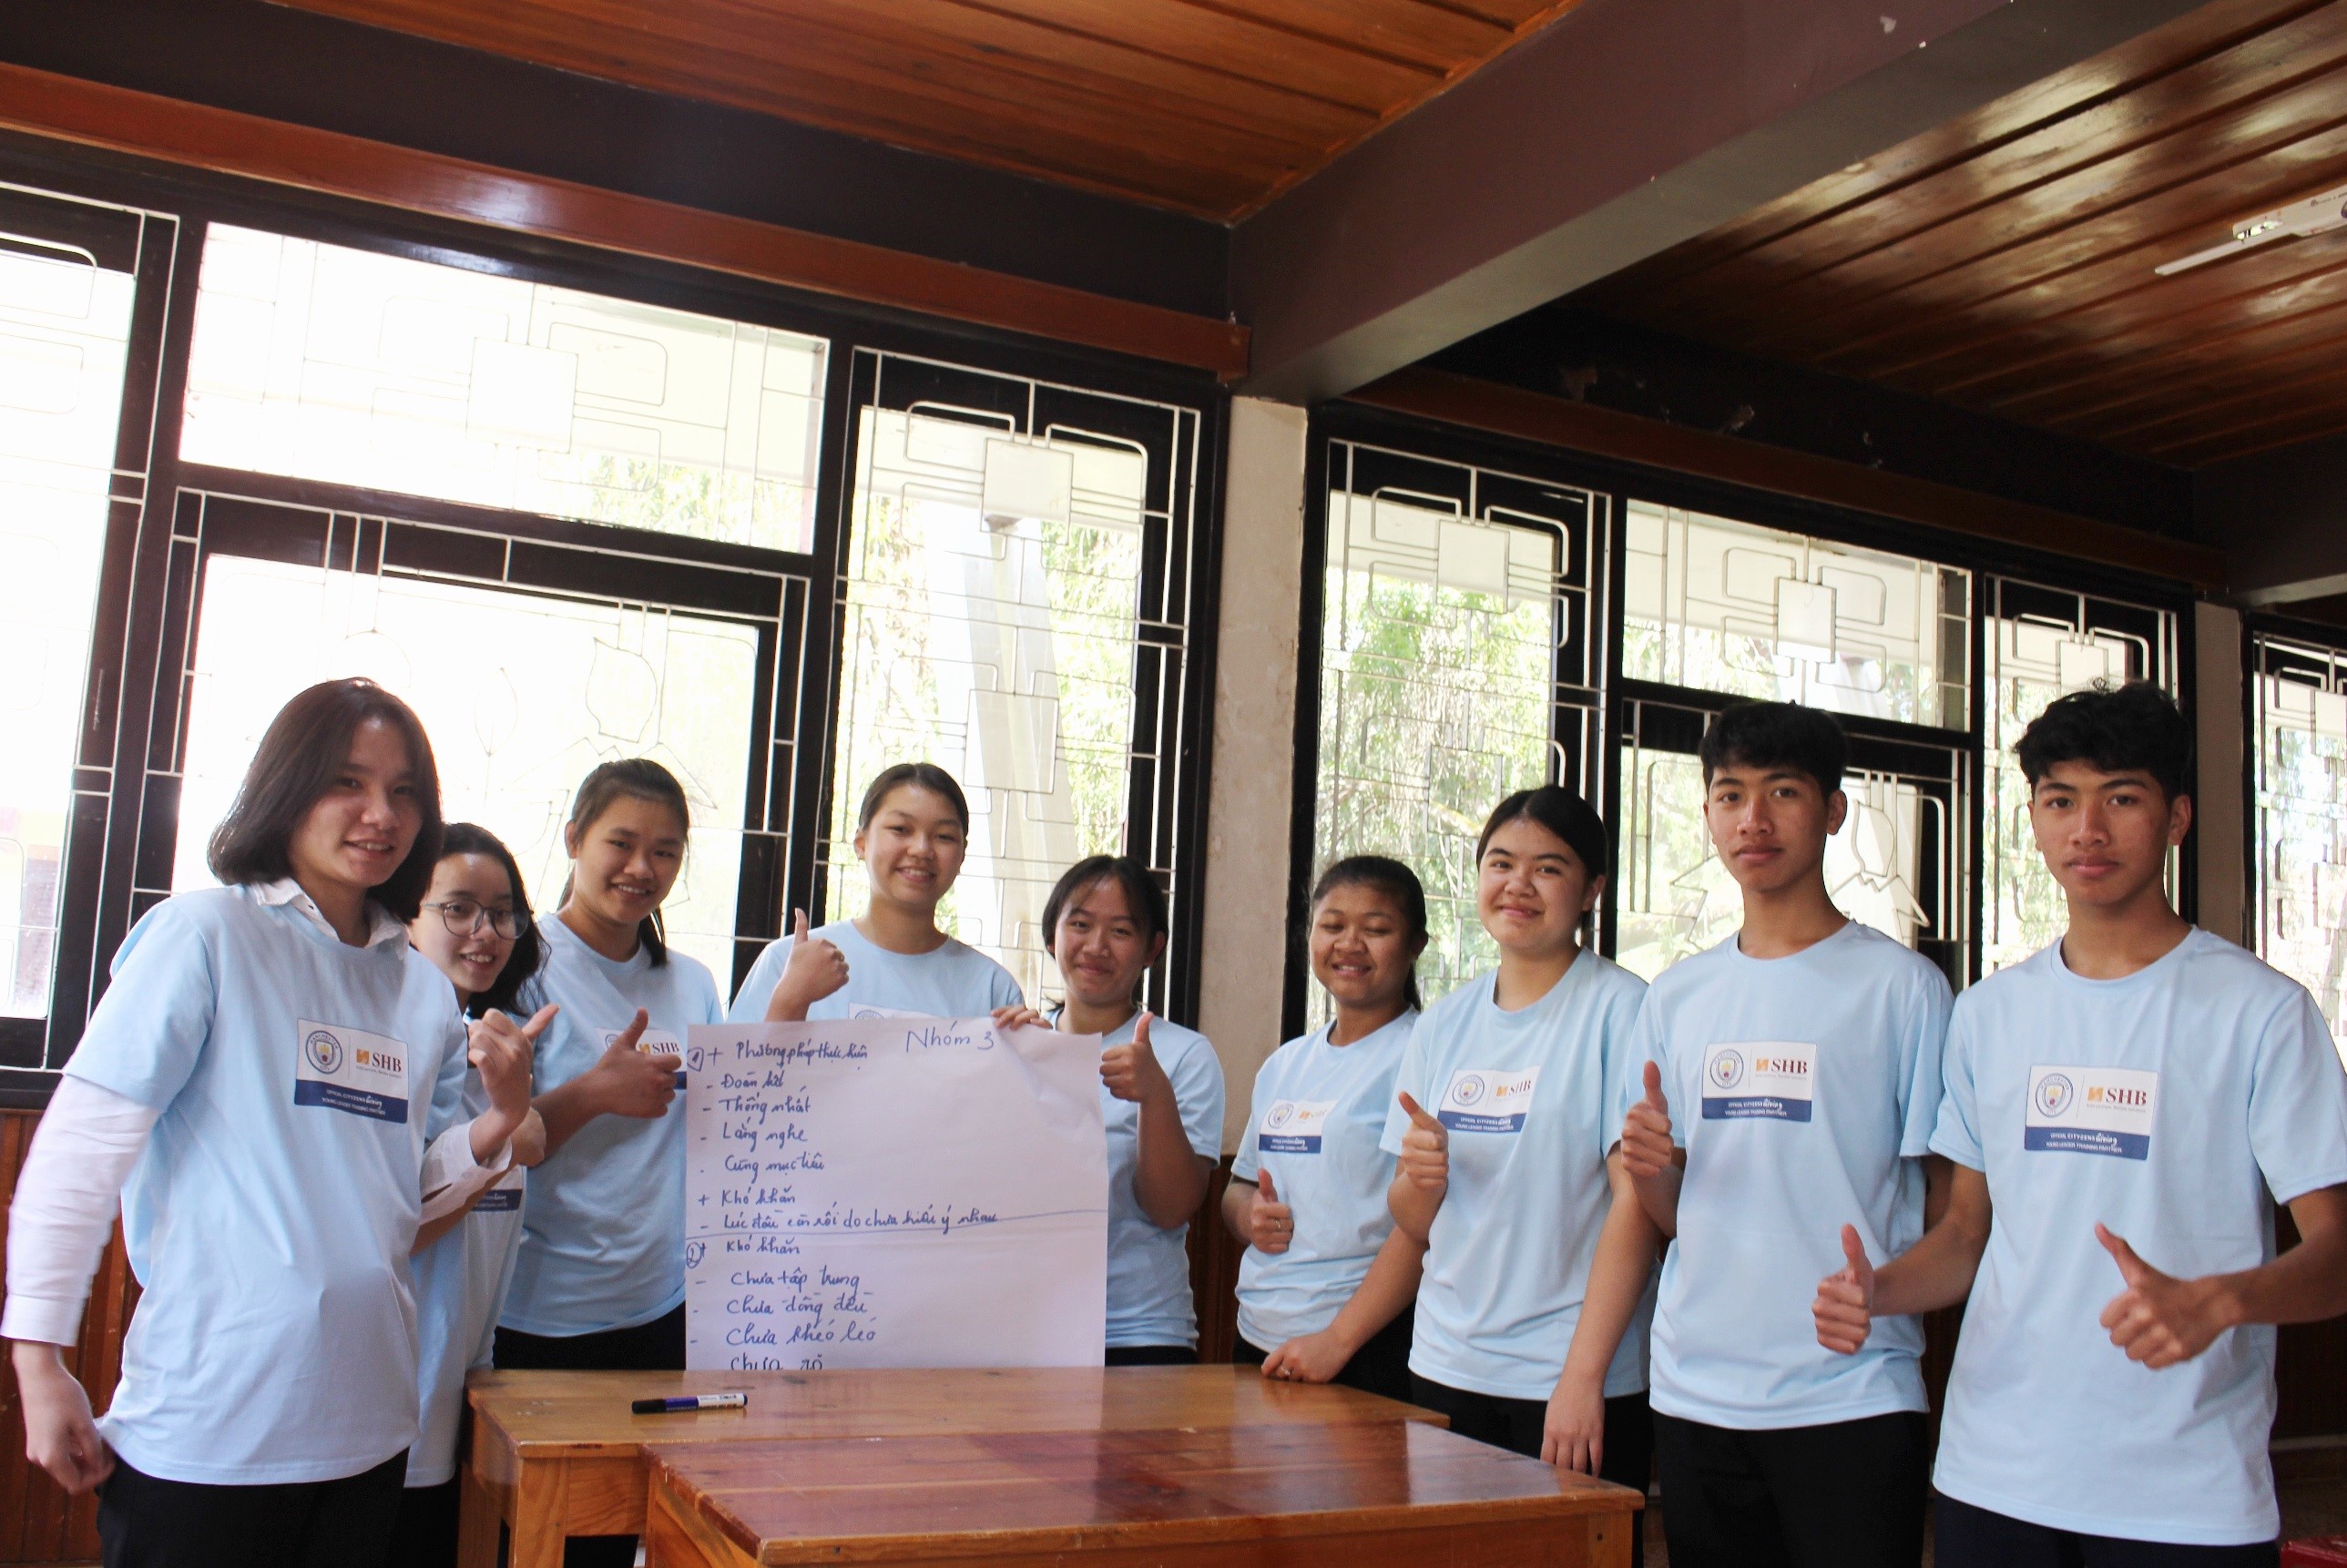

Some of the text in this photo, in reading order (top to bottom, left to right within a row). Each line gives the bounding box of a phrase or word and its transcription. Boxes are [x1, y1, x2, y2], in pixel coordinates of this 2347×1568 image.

[906, 1019, 995, 1053] Nhóm 3
[652, 1042, 680, 1054] SHB
[372, 1053, 402, 1073] SHB
[1770, 1057, 1808, 1074] SHB
[718, 1084, 812, 1125] Thống nhất
[2106, 1087, 2147, 1105] SHB
[765, 1123, 808, 1149] nghe
[721, 1186, 750, 1207] Khó
[755, 1185, 795, 1206] khăn
[724, 1211, 749, 1229] Lúc
[843, 1208, 861, 1228] do
[865, 1208, 897, 1227] chưa
[941, 1204, 952, 1235] ý
[957, 1207, 998, 1225] nhau
[727, 1235, 750, 1252] Khó
[757, 1236, 801, 1255] khăn
[730, 1265, 860, 1297] Chưa tập trung
[727, 1294, 774, 1314] Chưa
[726, 1317, 877, 1346] Chưa khéo léo
